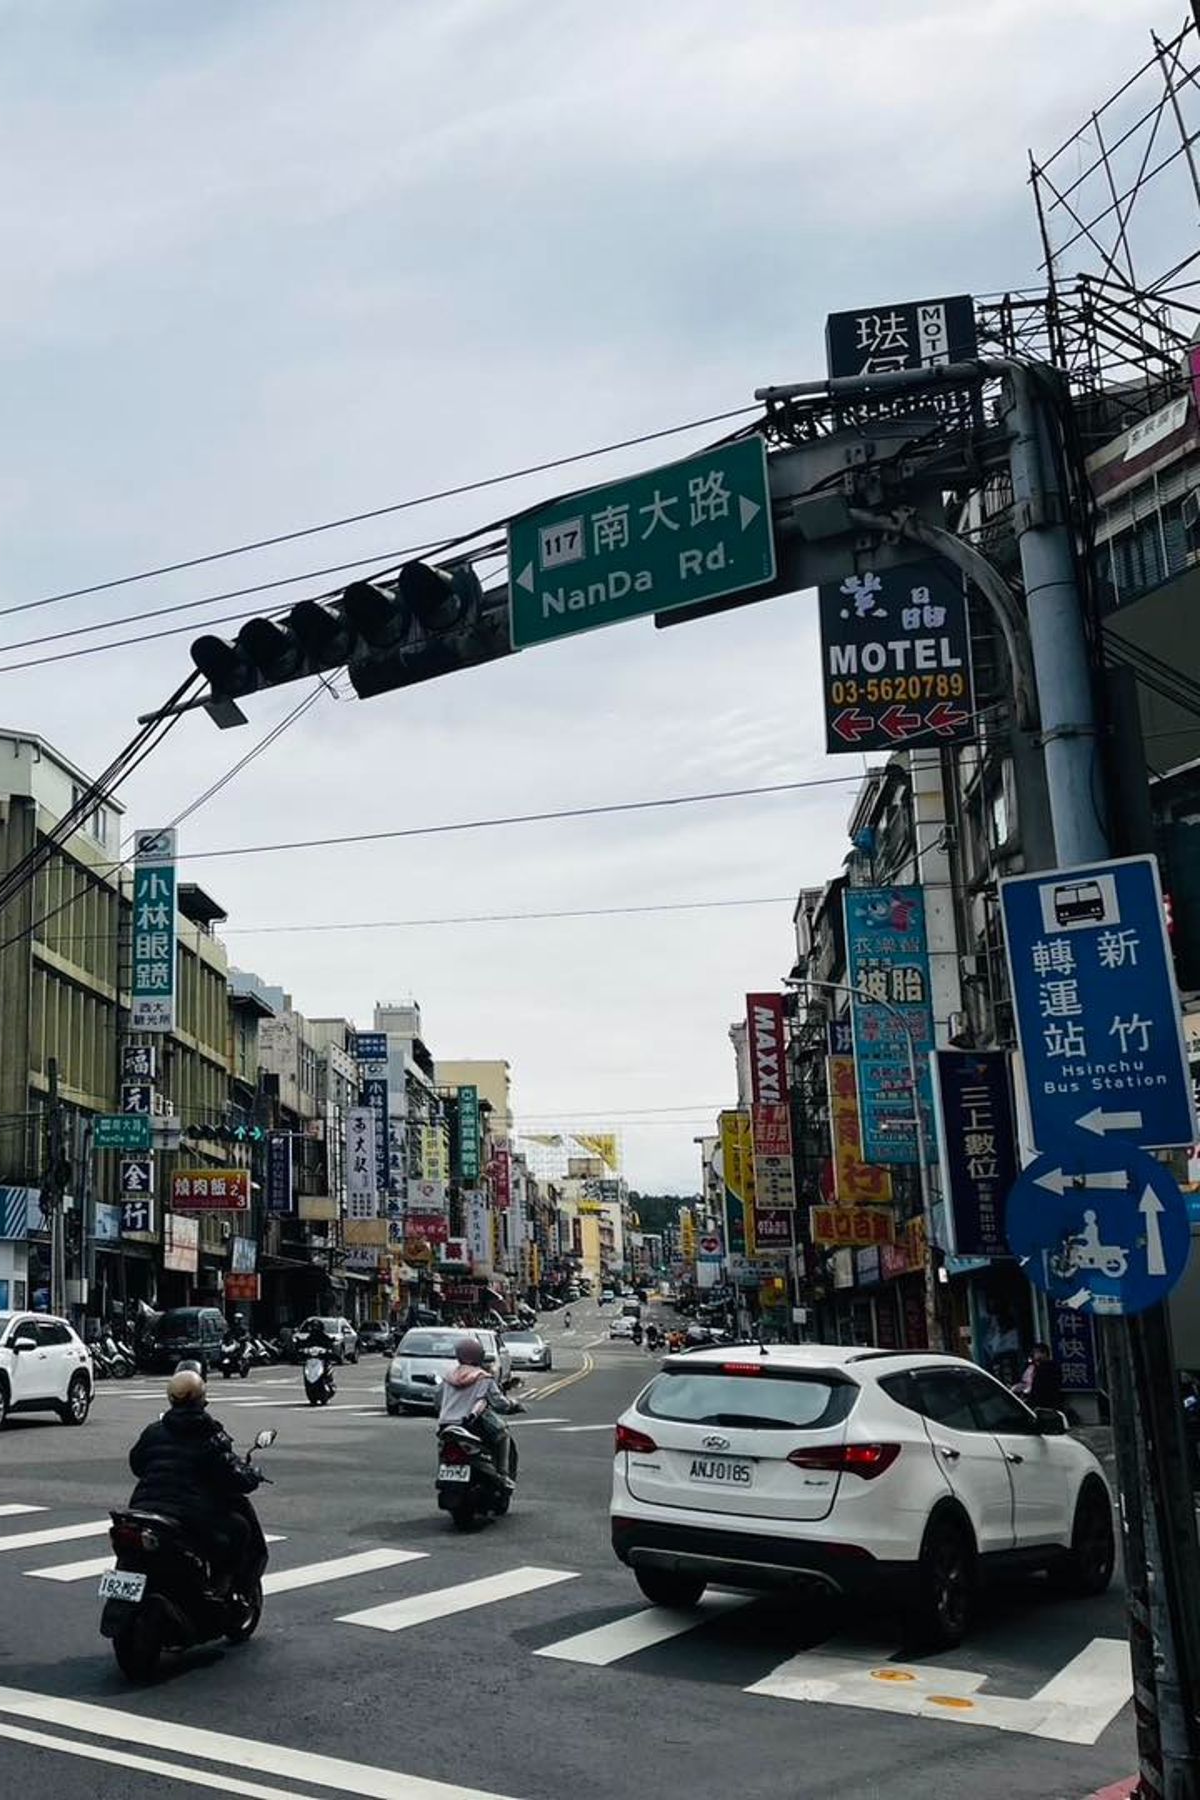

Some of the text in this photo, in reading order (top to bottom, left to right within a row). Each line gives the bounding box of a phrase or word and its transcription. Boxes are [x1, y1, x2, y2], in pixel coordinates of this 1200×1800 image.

[591, 470, 731, 555] 南大路
[545, 531, 578, 555] 117
[542, 542, 734, 618] NanDa Rd.
[829, 638, 962, 675] MOTEL
[832, 674, 963, 703] 03-5620789
[136, 873, 170, 989] 小林眼鏡
[1031, 938, 1087, 1058] 轉運站
[1098, 929, 1153, 1053] 新竹
[1044, 1073, 1167, 1094] Bus Station
[1062, 1059, 1144, 1077] Hsinchu
[960, 1086, 999, 1180] 三上數位
[175, 1178, 226, 1196] 燒肉飯
